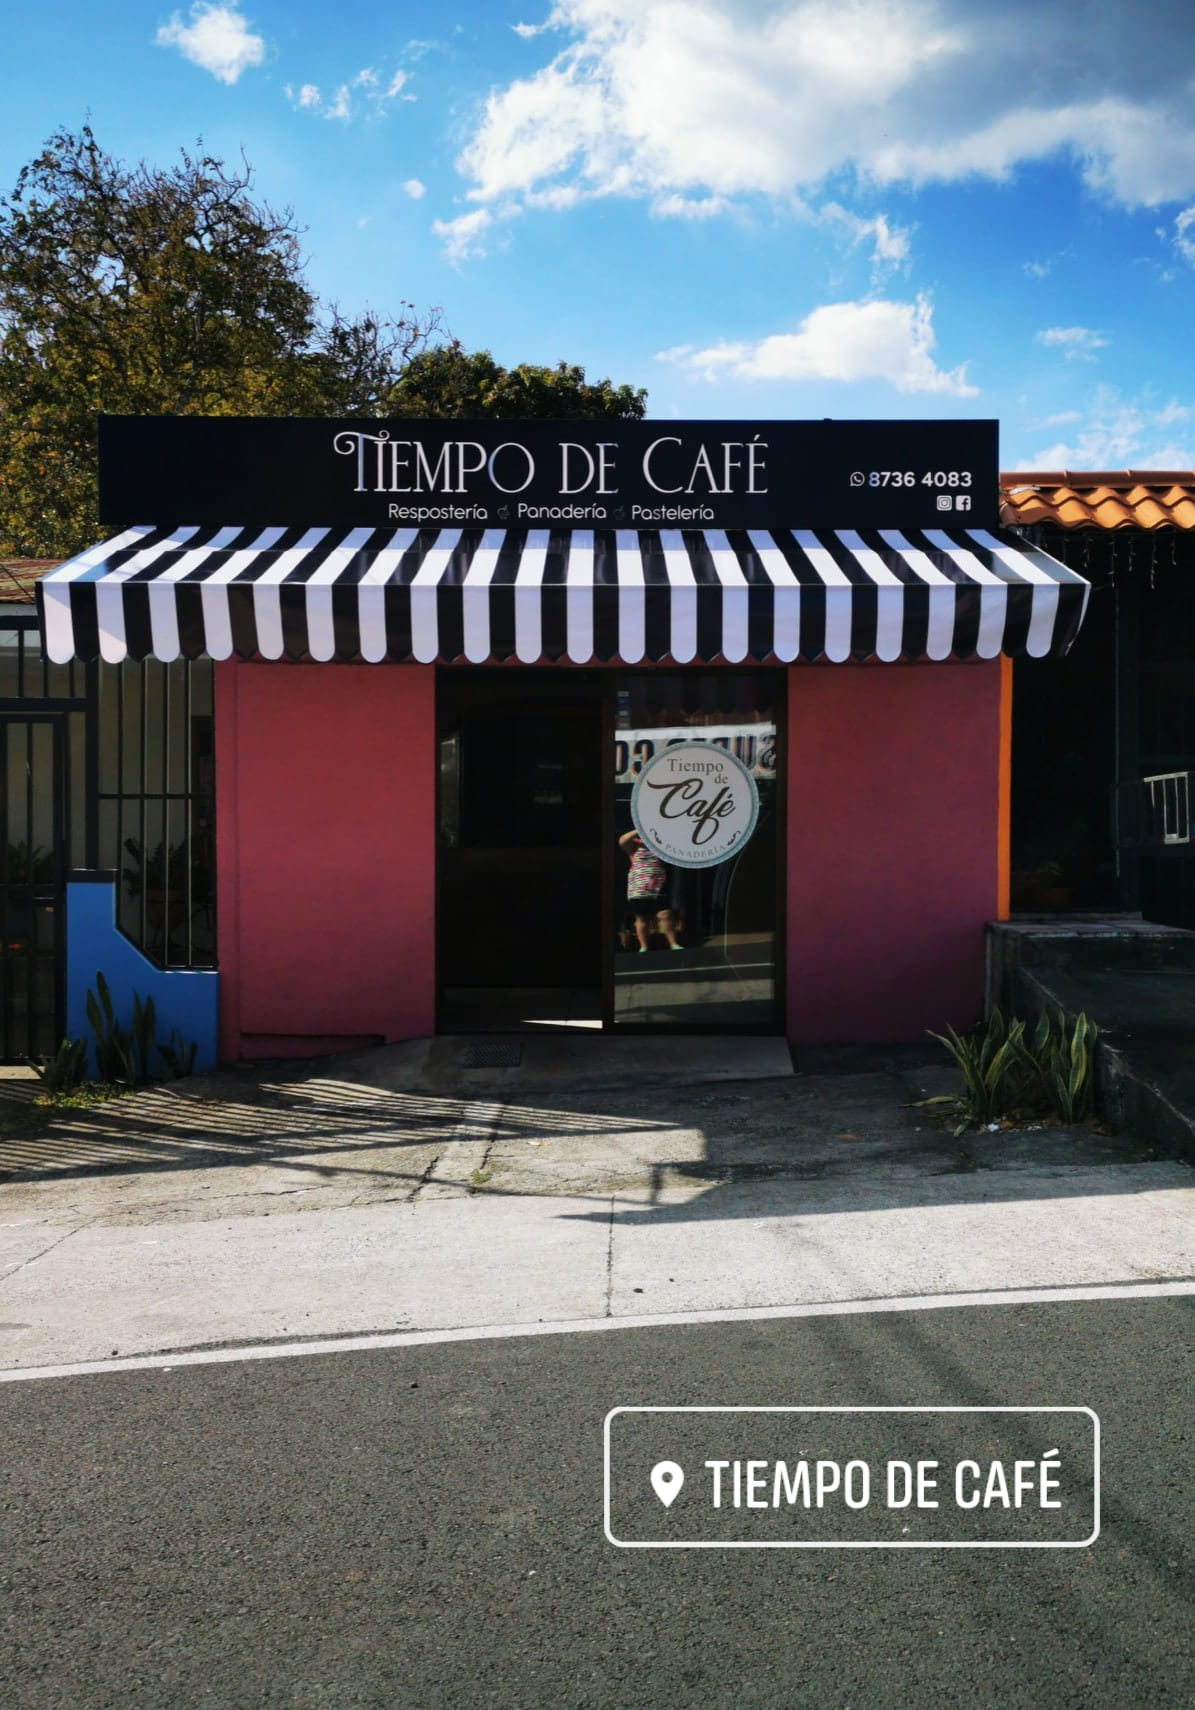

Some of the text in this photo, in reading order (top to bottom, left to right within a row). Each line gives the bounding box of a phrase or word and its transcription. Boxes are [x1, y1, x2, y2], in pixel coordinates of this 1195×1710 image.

[333, 430, 769, 494] TIEMPO DE CAFÉ
[869, 472, 972, 487] 8736 4083
[388, 503, 714, 522] Respostería Panadería Pastelería
[667, 758, 724, 776] Tiempo
[714, 774, 728, 785] de
[646, 778, 736, 846] Café
